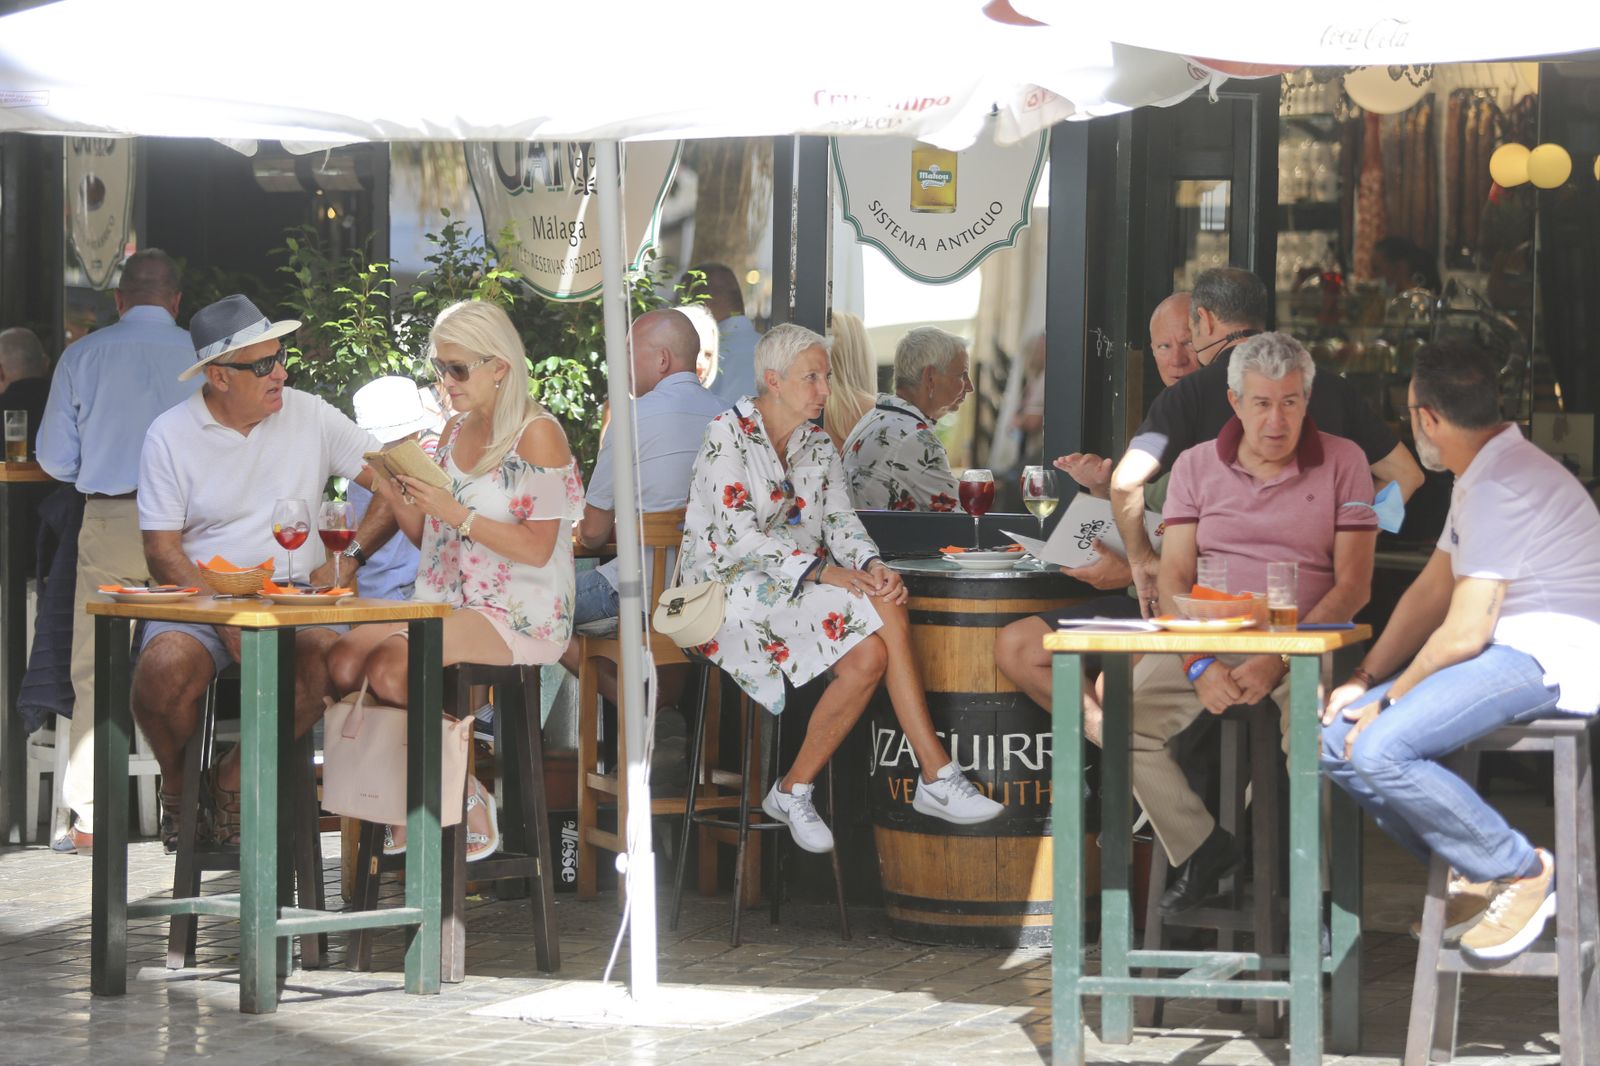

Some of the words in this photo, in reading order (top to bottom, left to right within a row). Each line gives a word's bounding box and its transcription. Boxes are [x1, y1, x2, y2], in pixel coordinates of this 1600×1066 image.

[532, 215, 587, 247] Málaga
[868, 200, 927, 251] SISTEMA
[936, 200, 1003, 251] ANTIGUO
[1073, 522, 1092, 540] LOS
[561, 820, 579, 883] ellesse
